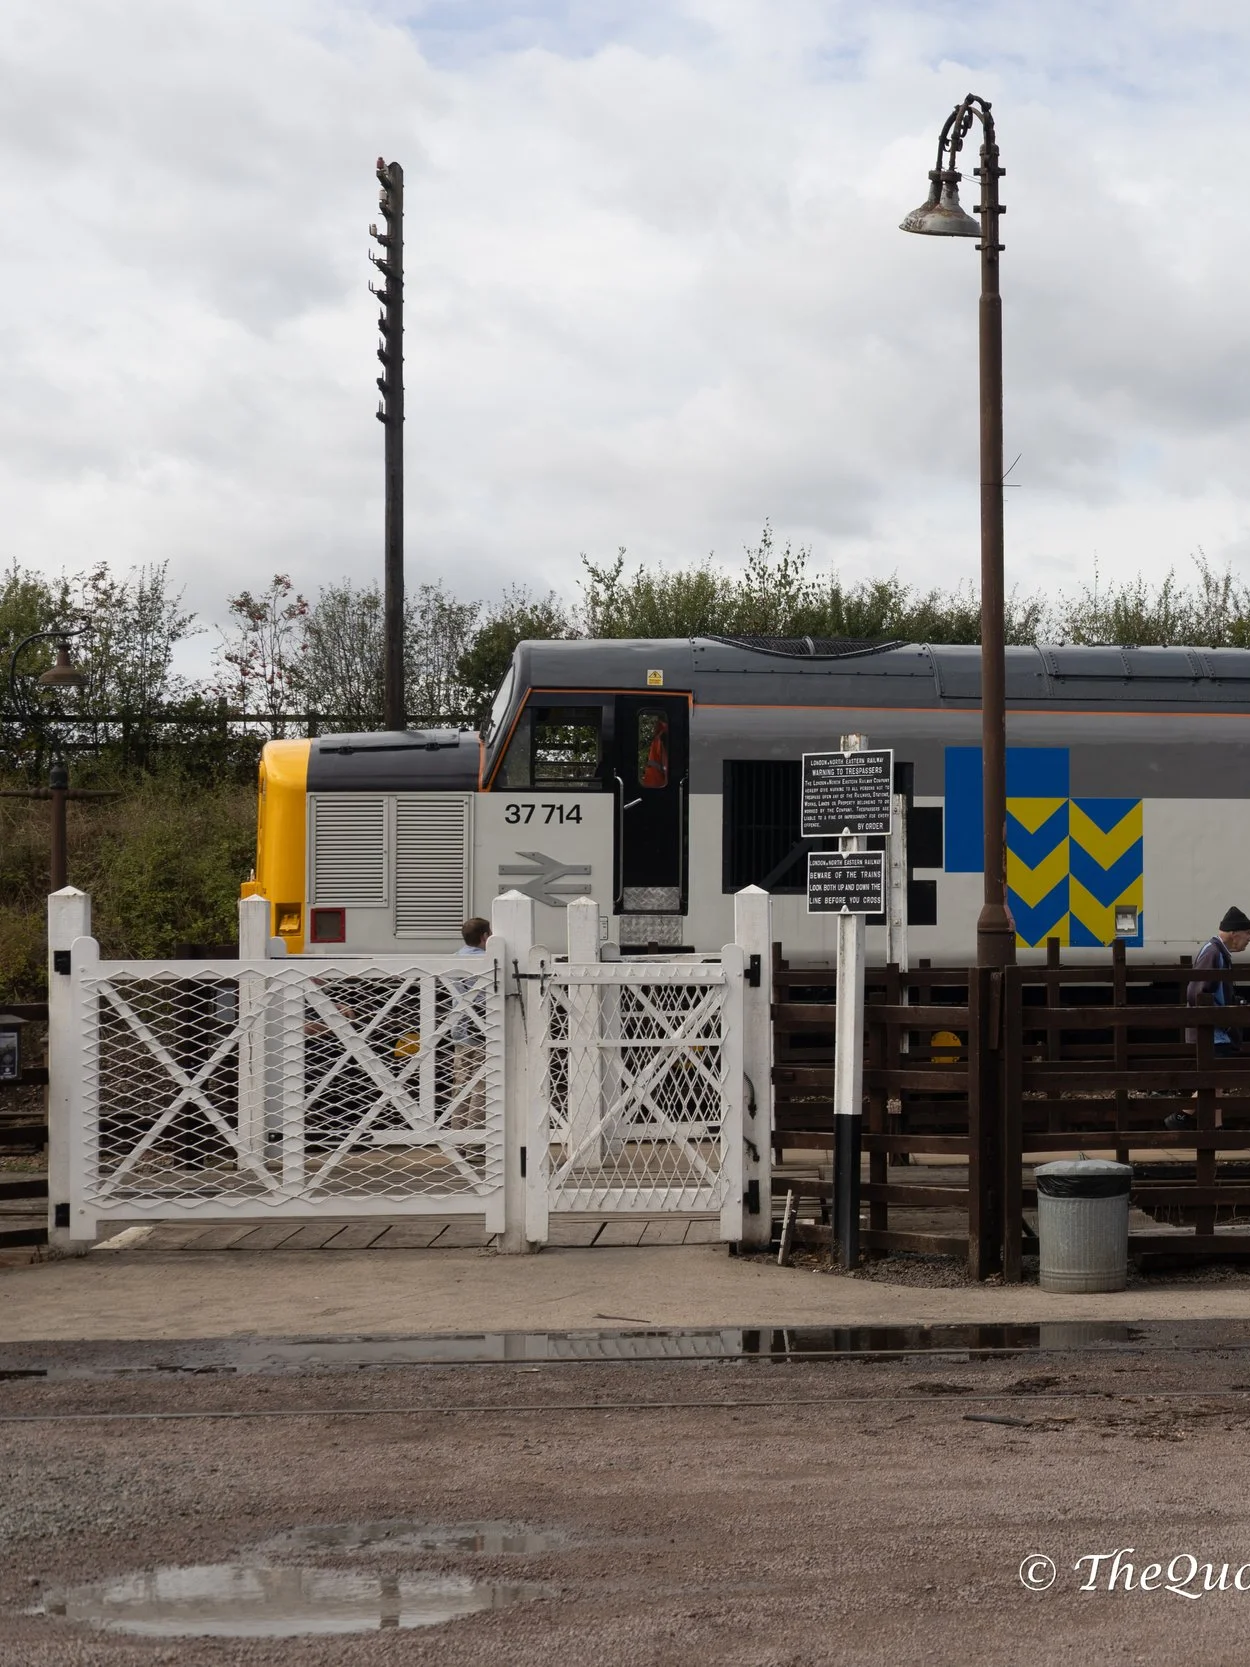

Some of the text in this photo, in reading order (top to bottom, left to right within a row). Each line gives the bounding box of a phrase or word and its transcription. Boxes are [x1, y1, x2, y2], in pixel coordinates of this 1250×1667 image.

[846, 767, 882, 775] TRESPASSERS
[505, 804, 582, 824] 37 714
[810, 871, 831, 879] BEWARE
